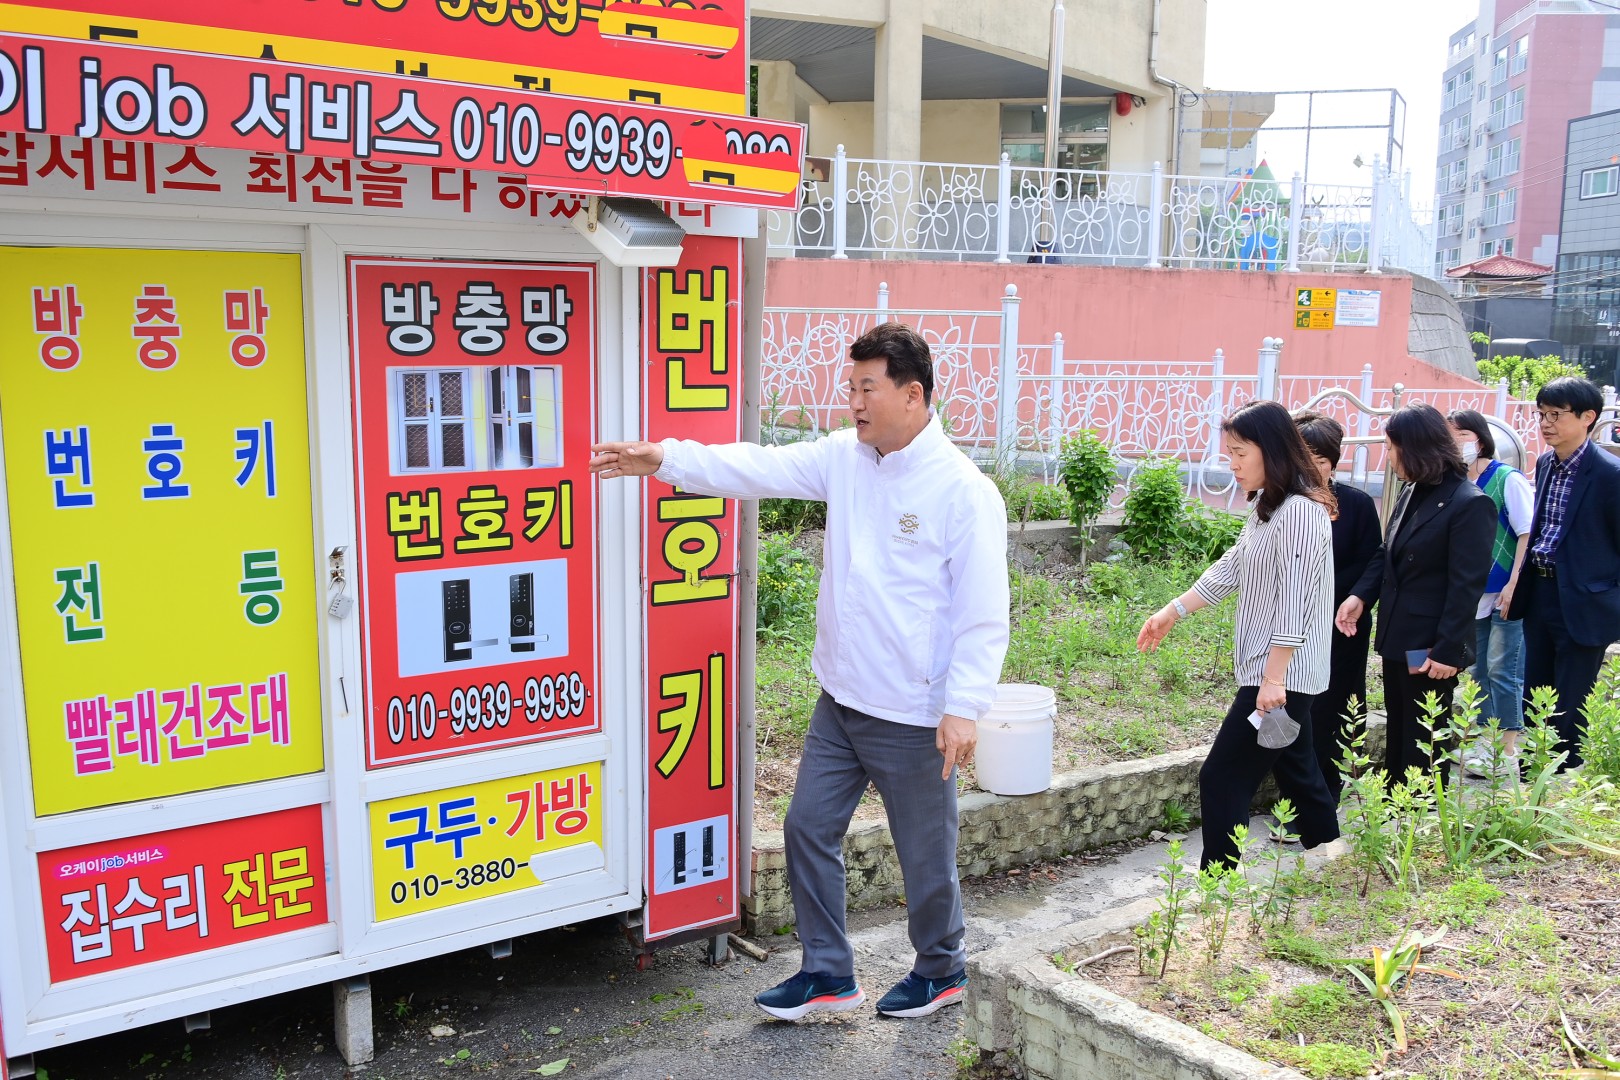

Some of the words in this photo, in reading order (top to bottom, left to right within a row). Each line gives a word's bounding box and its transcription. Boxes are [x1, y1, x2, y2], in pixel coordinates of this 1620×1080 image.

[75, 56, 208, 139] job
[231, 73, 442, 158] 서비스
[247, 151, 408, 208] 최선을
[380, 280, 574, 357] 방충망
[385, 480, 574, 562] 번호키
[64, 672, 291, 776] 빨래건조대
[387, 671, 585, 744] 010-9939-9939
[60, 864, 209, 964] 집수리
[222, 845, 315, 929] 전문
